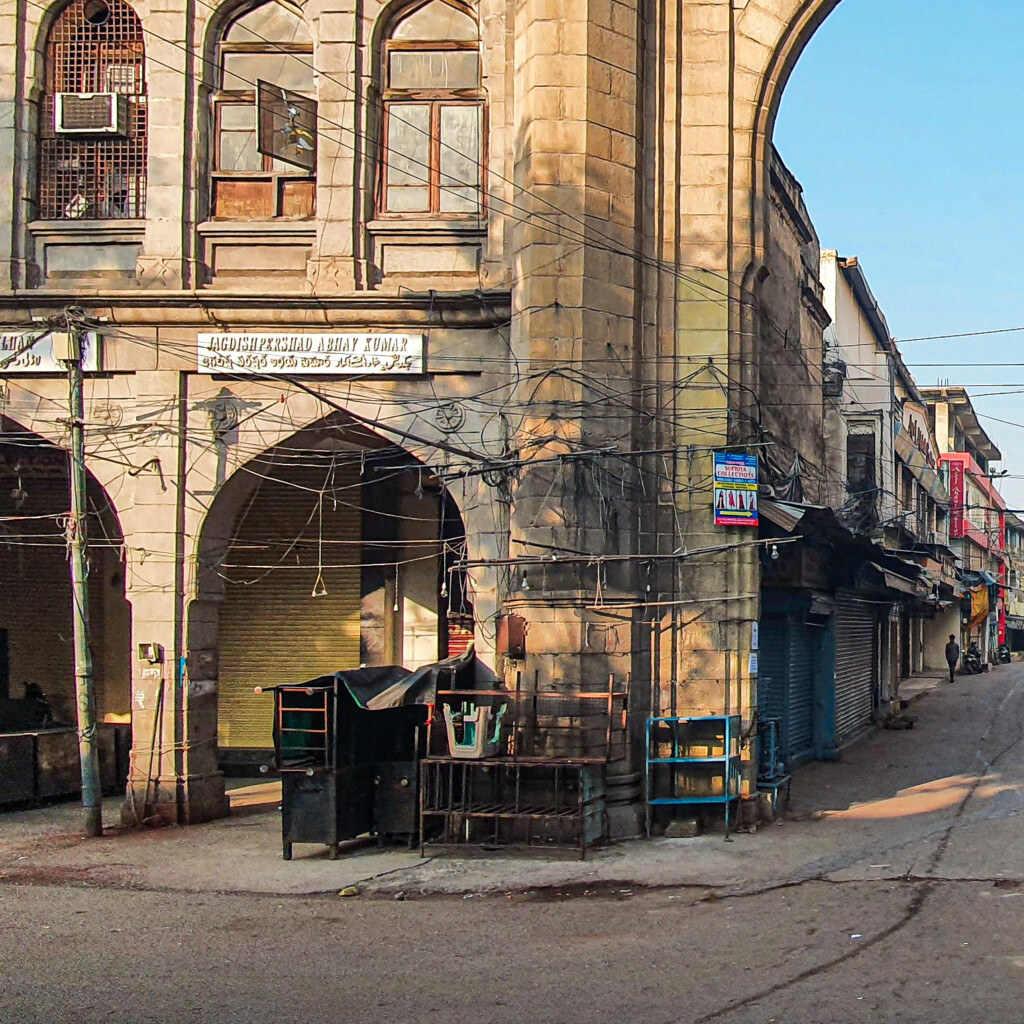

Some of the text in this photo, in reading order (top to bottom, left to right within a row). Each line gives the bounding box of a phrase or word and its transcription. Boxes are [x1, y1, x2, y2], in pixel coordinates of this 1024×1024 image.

[317, 337, 359, 352] ABHAY
[363, 337, 408, 352] KUMAR
[717, 470, 755, 479] COLLECTIONS
